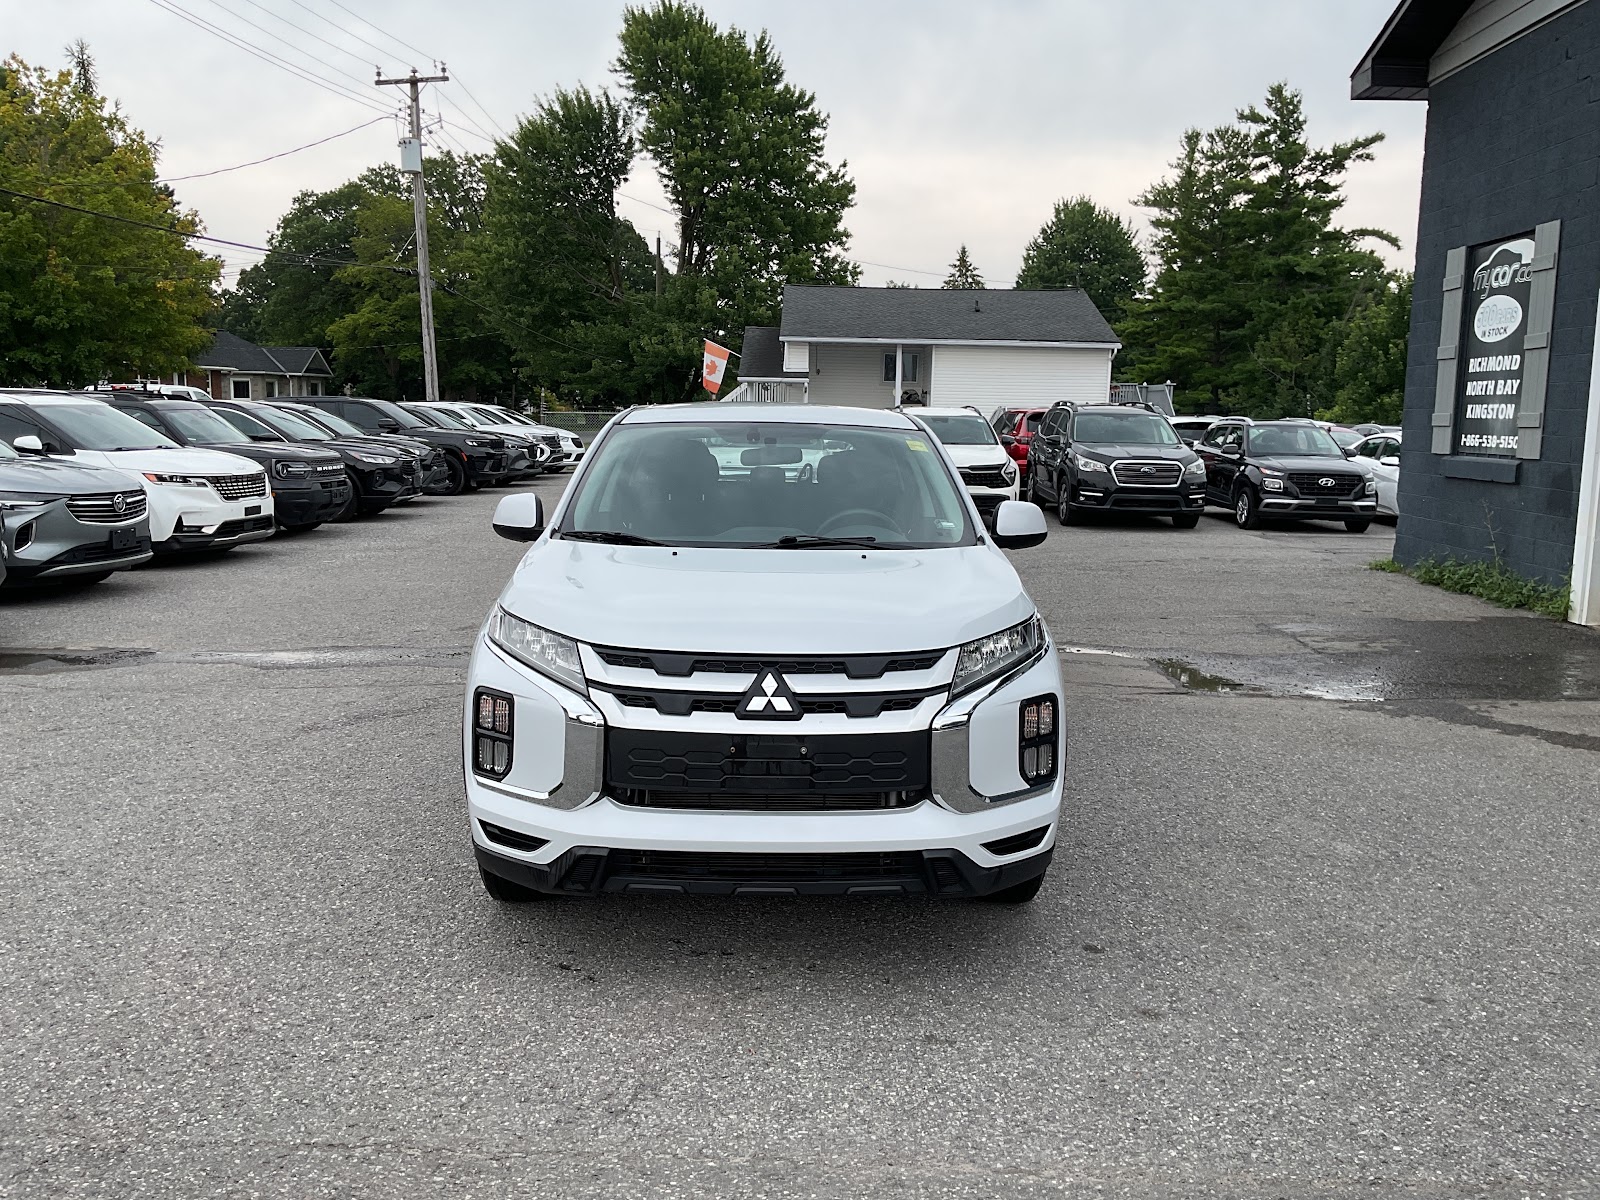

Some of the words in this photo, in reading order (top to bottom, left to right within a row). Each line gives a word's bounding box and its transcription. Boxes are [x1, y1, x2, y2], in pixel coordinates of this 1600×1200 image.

[1480, 330, 1487, 338] IN
[1487, 326, 1509, 338] STOCK
[1468, 354, 1521, 373] RICHMOND
[1466, 380, 1496, 396] NORTH
[1496, 379, 1520, 395] BAY
[1466, 404, 1515, 419] KINGSTON
